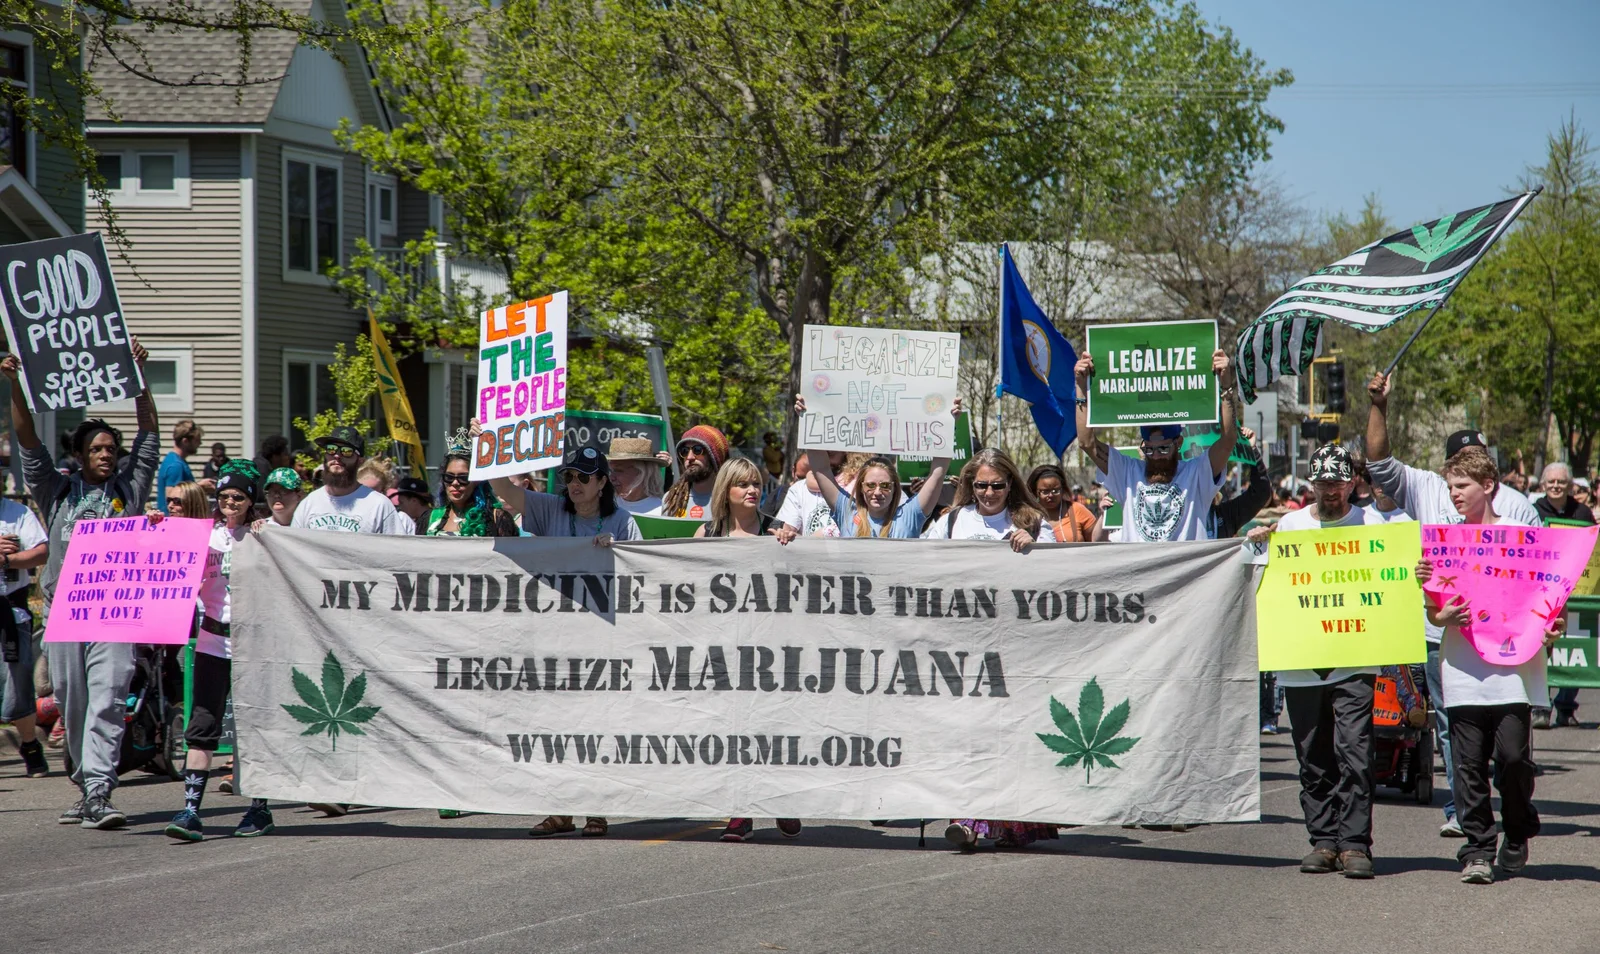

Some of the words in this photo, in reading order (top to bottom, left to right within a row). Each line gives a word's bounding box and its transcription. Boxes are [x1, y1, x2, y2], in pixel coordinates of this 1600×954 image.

[7, 249, 101, 320] GOOD
[486, 294, 553, 342] LET
[27, 312, 126, 354] PEOPLE
[59, 351, 95, 370] DO
[481, 331, 557, 384] THE
[810, 329, 957, 379] LEGALIZE
[1108, 347, 1197, 374] LEGALIZE
[45, 363, 128, 390] SMOKE
[1099, 376, 1169, 394] MARIJUANA
[1171, 375, 1185, 391] IN
[1187, 374, 1207, 390] MN
[39, 382, 126, 410] WEED
[480, 367, 565, 425] PEOPLE
[848, 381, 906, 415] NOT
[1117, 411, 1189, 420] WWW.MNNORML.ORG
[476, 411, 565, 469] DECIDE
[804, 413, 875, 447] LEGAL
[890, 418, 946, 452] LIES
[77, 521, 100, 535] MY
[103, 519, 136, 533] WISH
[1424, 528, 1448, 543] MY
[1461, 528, 1507, 545] WISH
[80, 553, 98, 566] TO
[104, 551, 139, 564] STAY
[144, 550, 198, 565] ALIVE
[1276, 543, 1302, 559] MY
[1314, 540, 1361, 557] WISH
[1369, 539, 1385, 553] IS
[1468, 547, 1494, 557] MOM
[73, 569, 117, 585] RAISE
[121, 568, 147, 582] MY
[147, 566, 188, 582] KIDS
[1288, 572, 1312, 586] TO
[1321, 568, 1375, 585] GROW
[1380, 566, 1408, 582] OLD
[1432, 558, 1469, 571] ECOME
[1472, 564, 1481, 574] A
[1485, 566, 1524, 579] STATE
[67, 588, 108, 603] GROW
[114, 587, 145, 601] OLD
[150, 586, 193, 600] WITH
[319, 579, 379, 610] MY
[390, 572, 646, 614] MEDICINE
[659, 582, 696, 614] IS
[709, 573, 876, 616] SAFER
[889, 586, 998, 619] THAN
[1012, 588, 1157, 625] YOURS.
[1298, 593, 1345, 609] WITH
[1359, 592, 1385, 607] MY
[69, 607, 92, 621] MY
[100, 606, 144, 620] LOVE
[1321, 618, 1366, 634] WIFE
[433, 657, 633, 692] LEGALIZE
[648, 645, 1010, 698] MARIJUANA
[506, 733, 903, 768] WWW.MNNORML.ORG
